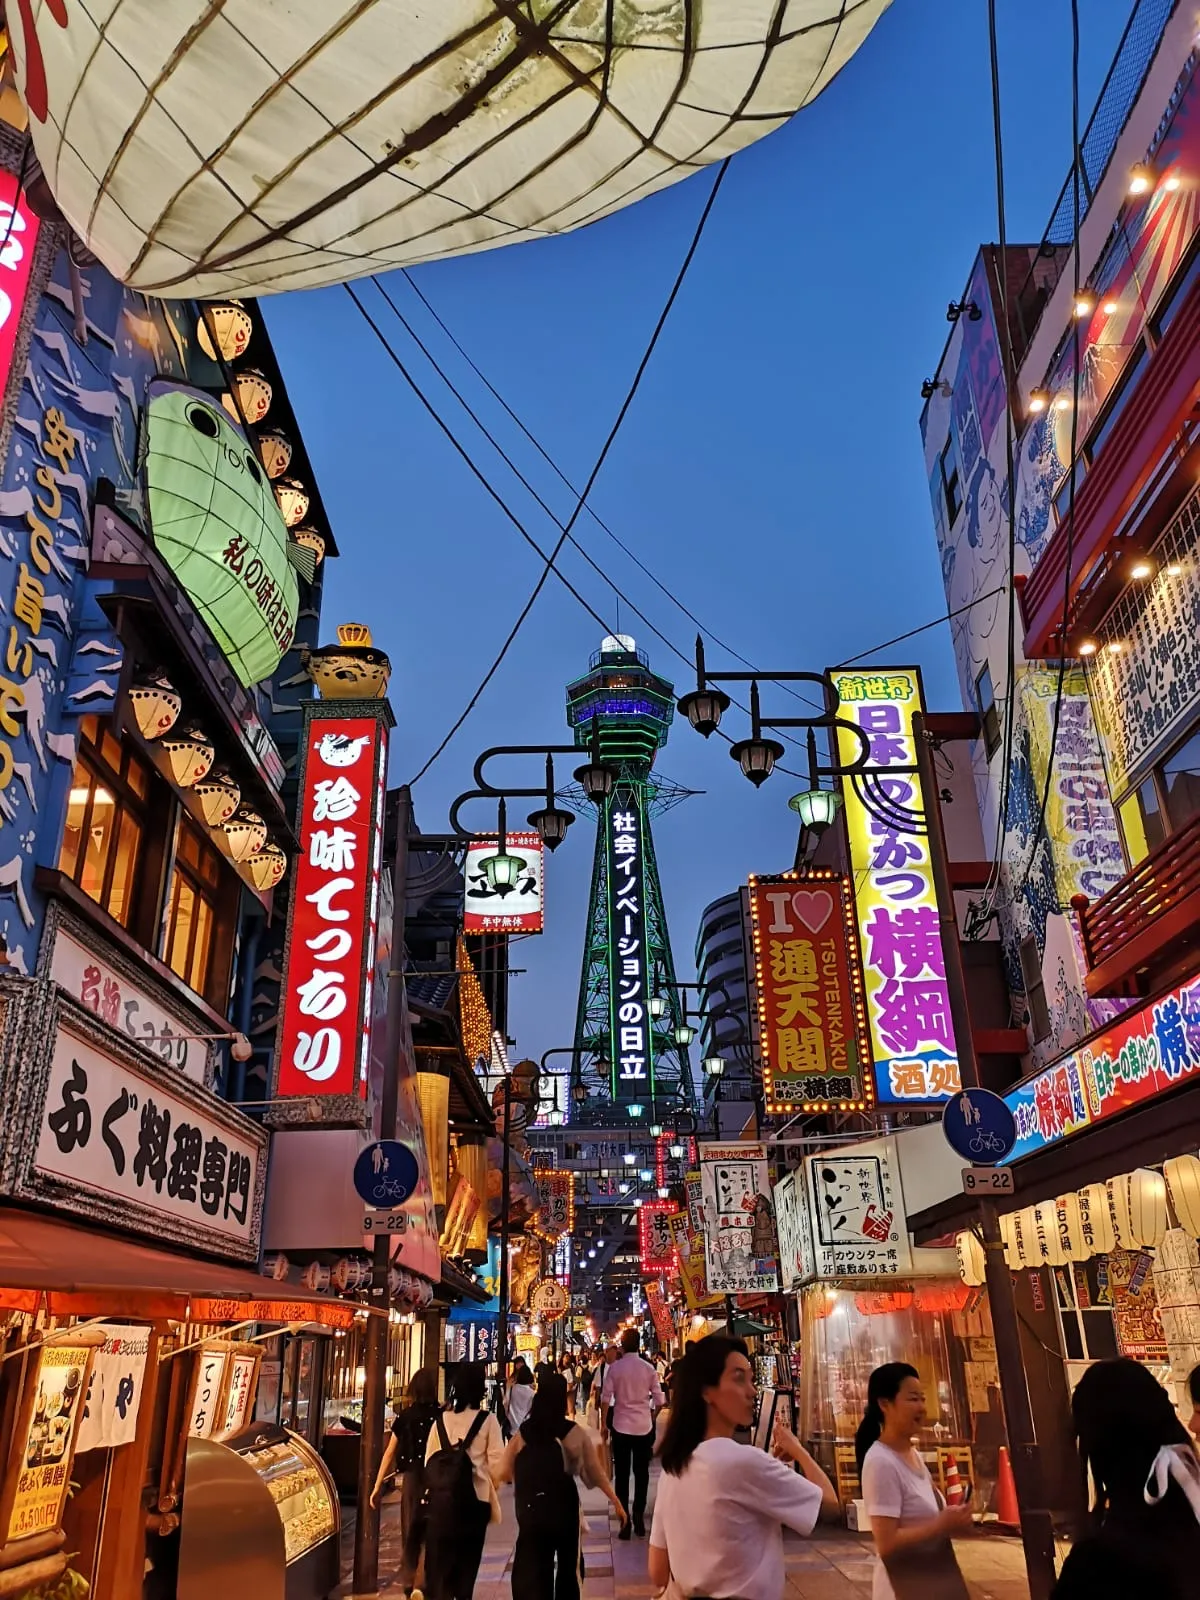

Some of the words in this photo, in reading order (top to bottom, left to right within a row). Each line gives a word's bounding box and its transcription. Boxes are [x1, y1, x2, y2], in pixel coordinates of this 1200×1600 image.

[838, 676, 913, 700] 新世界
[482, 916, 523, 927] 年中無休
[765, 892, 794, 934] I
[613, 811, 646, 1079] 社会イノベーションの日立
[769, 939, 827, 1073] 通天閣
[820, 938, 848, 1071] TSUTENKAKU
[552, 1179, 567, 1222] 串かつ
[857, 1167, 875, 1203] 新世界
[822, 1250, 833, 1261] 1F
[835, 1248, 897, 1261] カウンター席
[823, 1264, 834, 1274] 2F
[836, 1263, 898, 1275] 座敷あります
[710, 1277, 775, 1290] 宴会予約受付中
